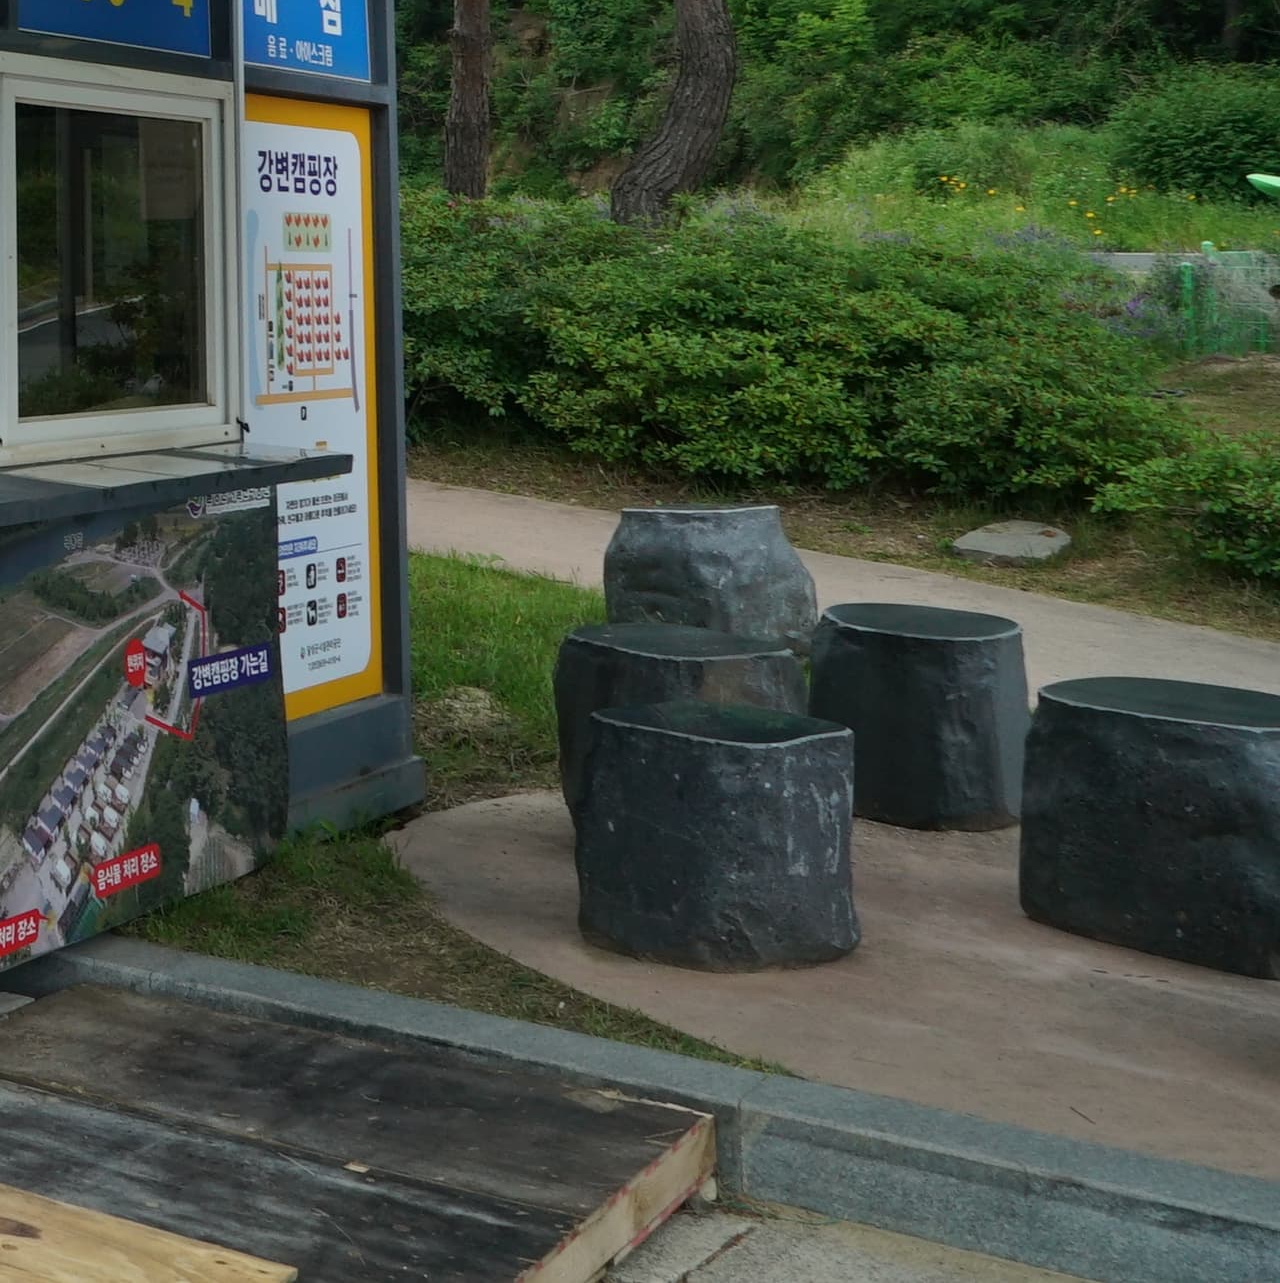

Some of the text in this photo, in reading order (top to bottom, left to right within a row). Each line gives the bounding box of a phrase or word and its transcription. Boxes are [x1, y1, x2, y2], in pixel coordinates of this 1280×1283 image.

[258, 150, 337, 196] 강변캠핑장
[192, 650, 268, 690] 강변캠핑장 가는길
[97, 850, 158, 890] 음식물 처리 장소
[17, 917, 36, 940] 장소
